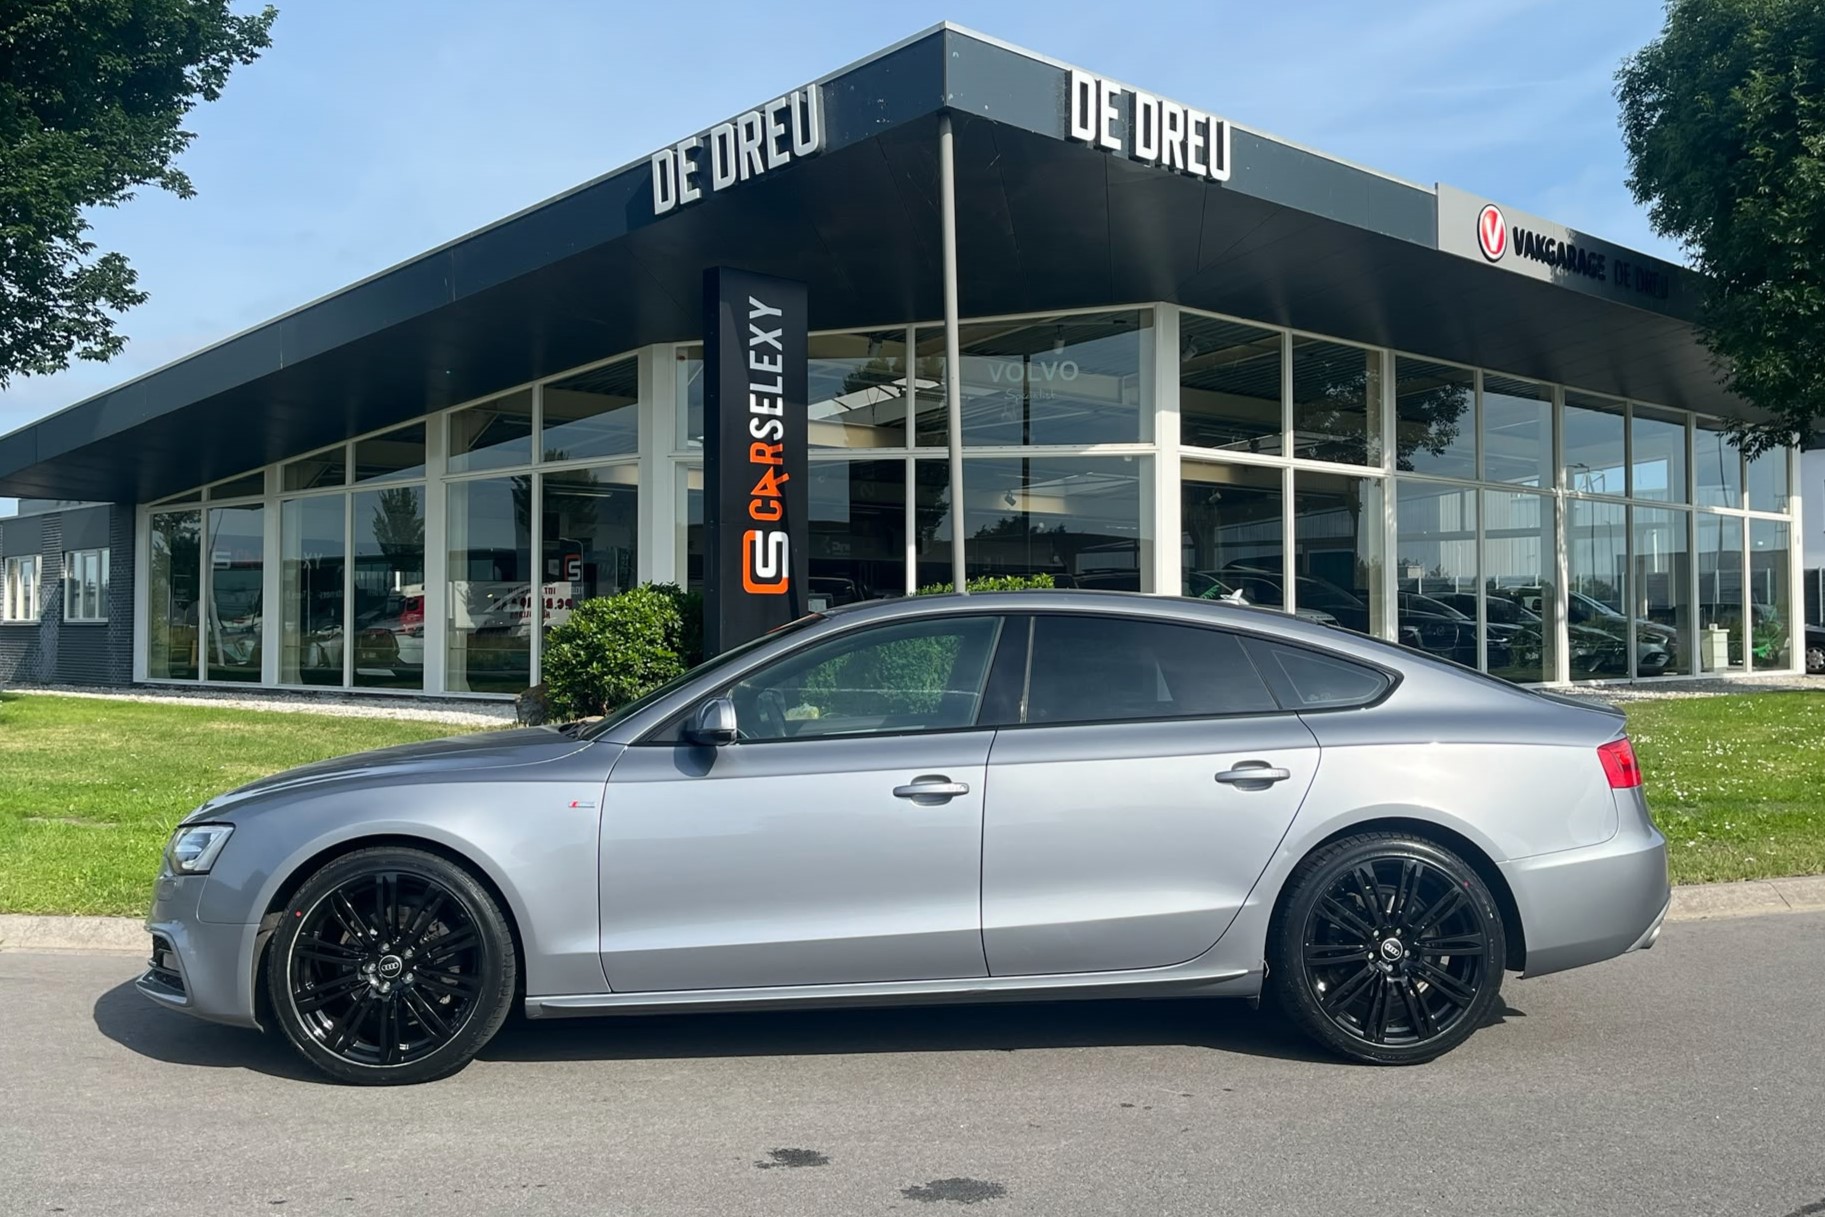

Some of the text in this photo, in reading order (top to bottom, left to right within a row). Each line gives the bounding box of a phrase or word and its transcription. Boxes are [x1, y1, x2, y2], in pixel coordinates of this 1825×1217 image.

[652, 84, 820, 215] DE DREU
[1071, 69, 1231, 182] DE DREU
[1512, 226, 1606, 280] VAKGARAGE
[1615, 259, 1631, 288] DE
[749, 294, 788, 520] CARSELEXY
[988, 361, 1079, 382] VOLVO
